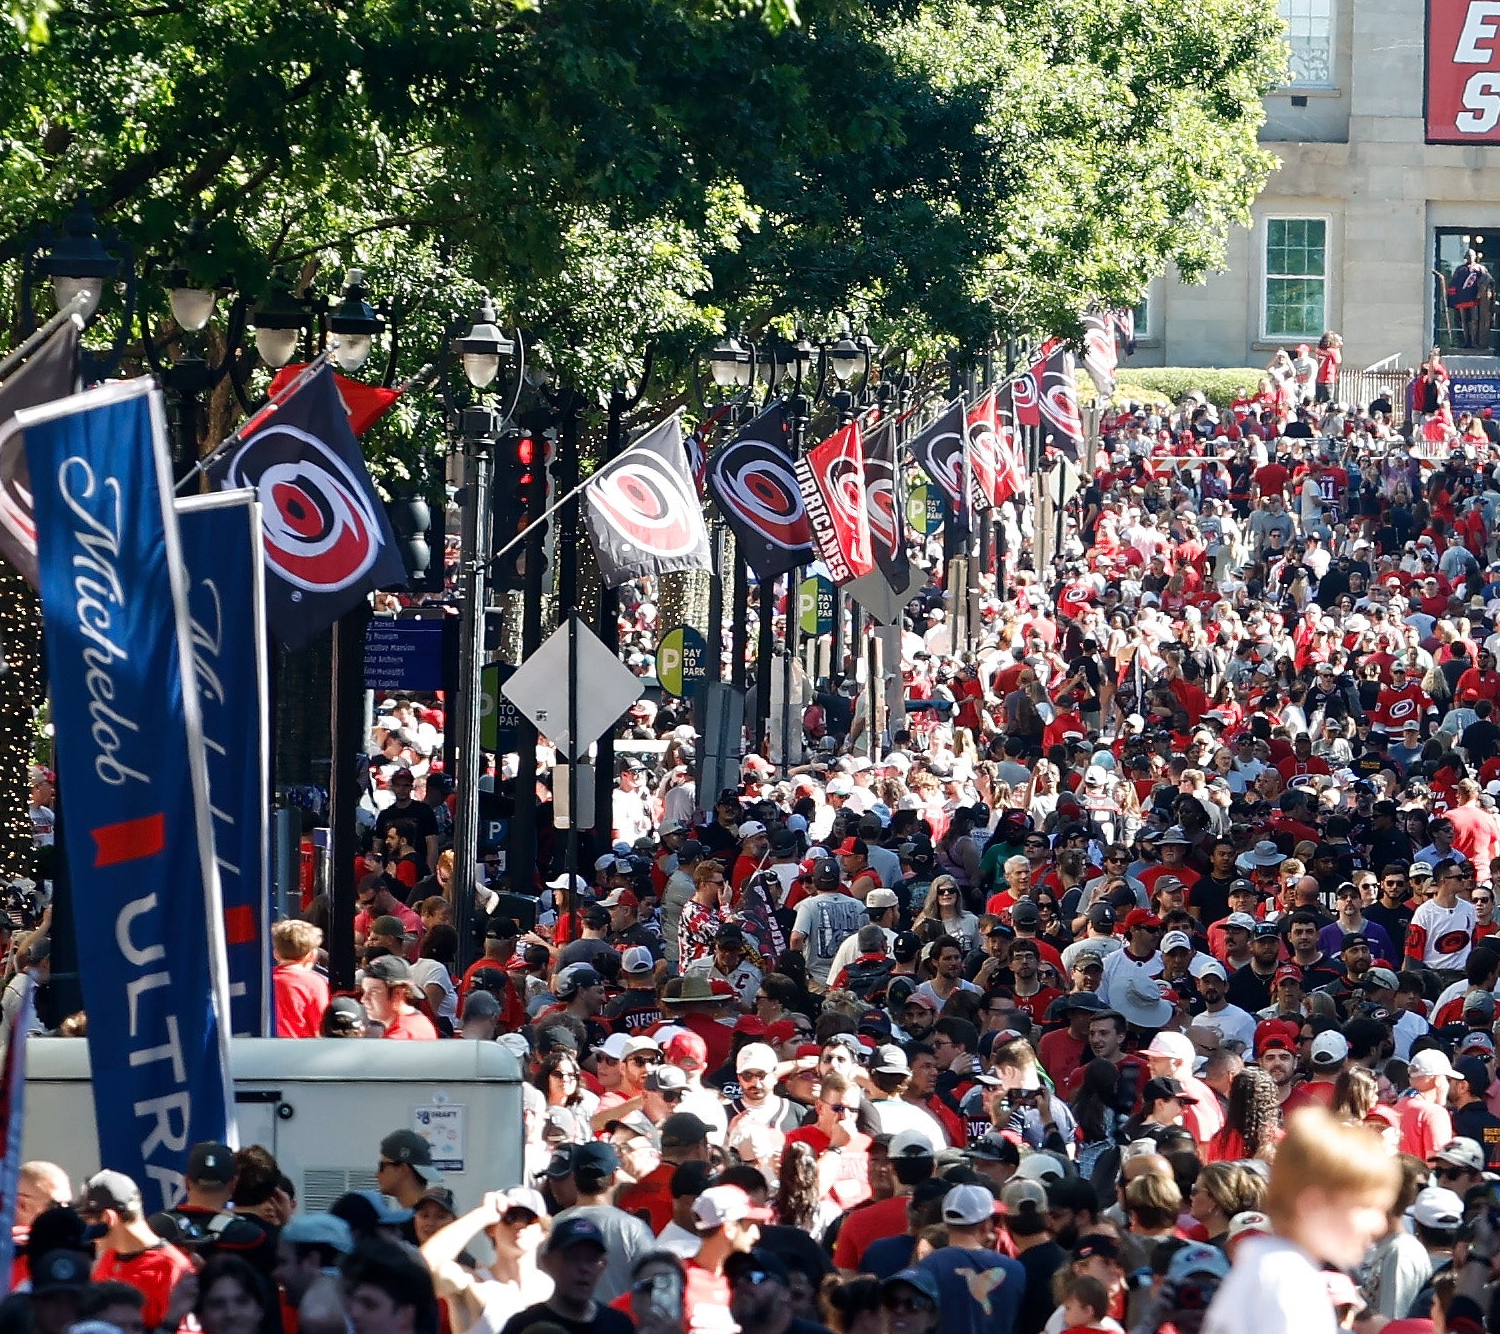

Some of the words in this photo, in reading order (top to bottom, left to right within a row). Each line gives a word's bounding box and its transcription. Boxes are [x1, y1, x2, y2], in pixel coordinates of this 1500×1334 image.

[1453, 384, 1496, 393] CAPITOL
[818, 609, 832, 617] PAR
[56, 453, 152, 787] Michelob
[683, 649, 702, 658] PAY
[662, 648, 680, 675] P
[683, 658, 696, 667] TO
[683, 667, 706, 676] PARK
[735, 973, 750, 989] C
[115, 892, 191, 1214] ULTRA
